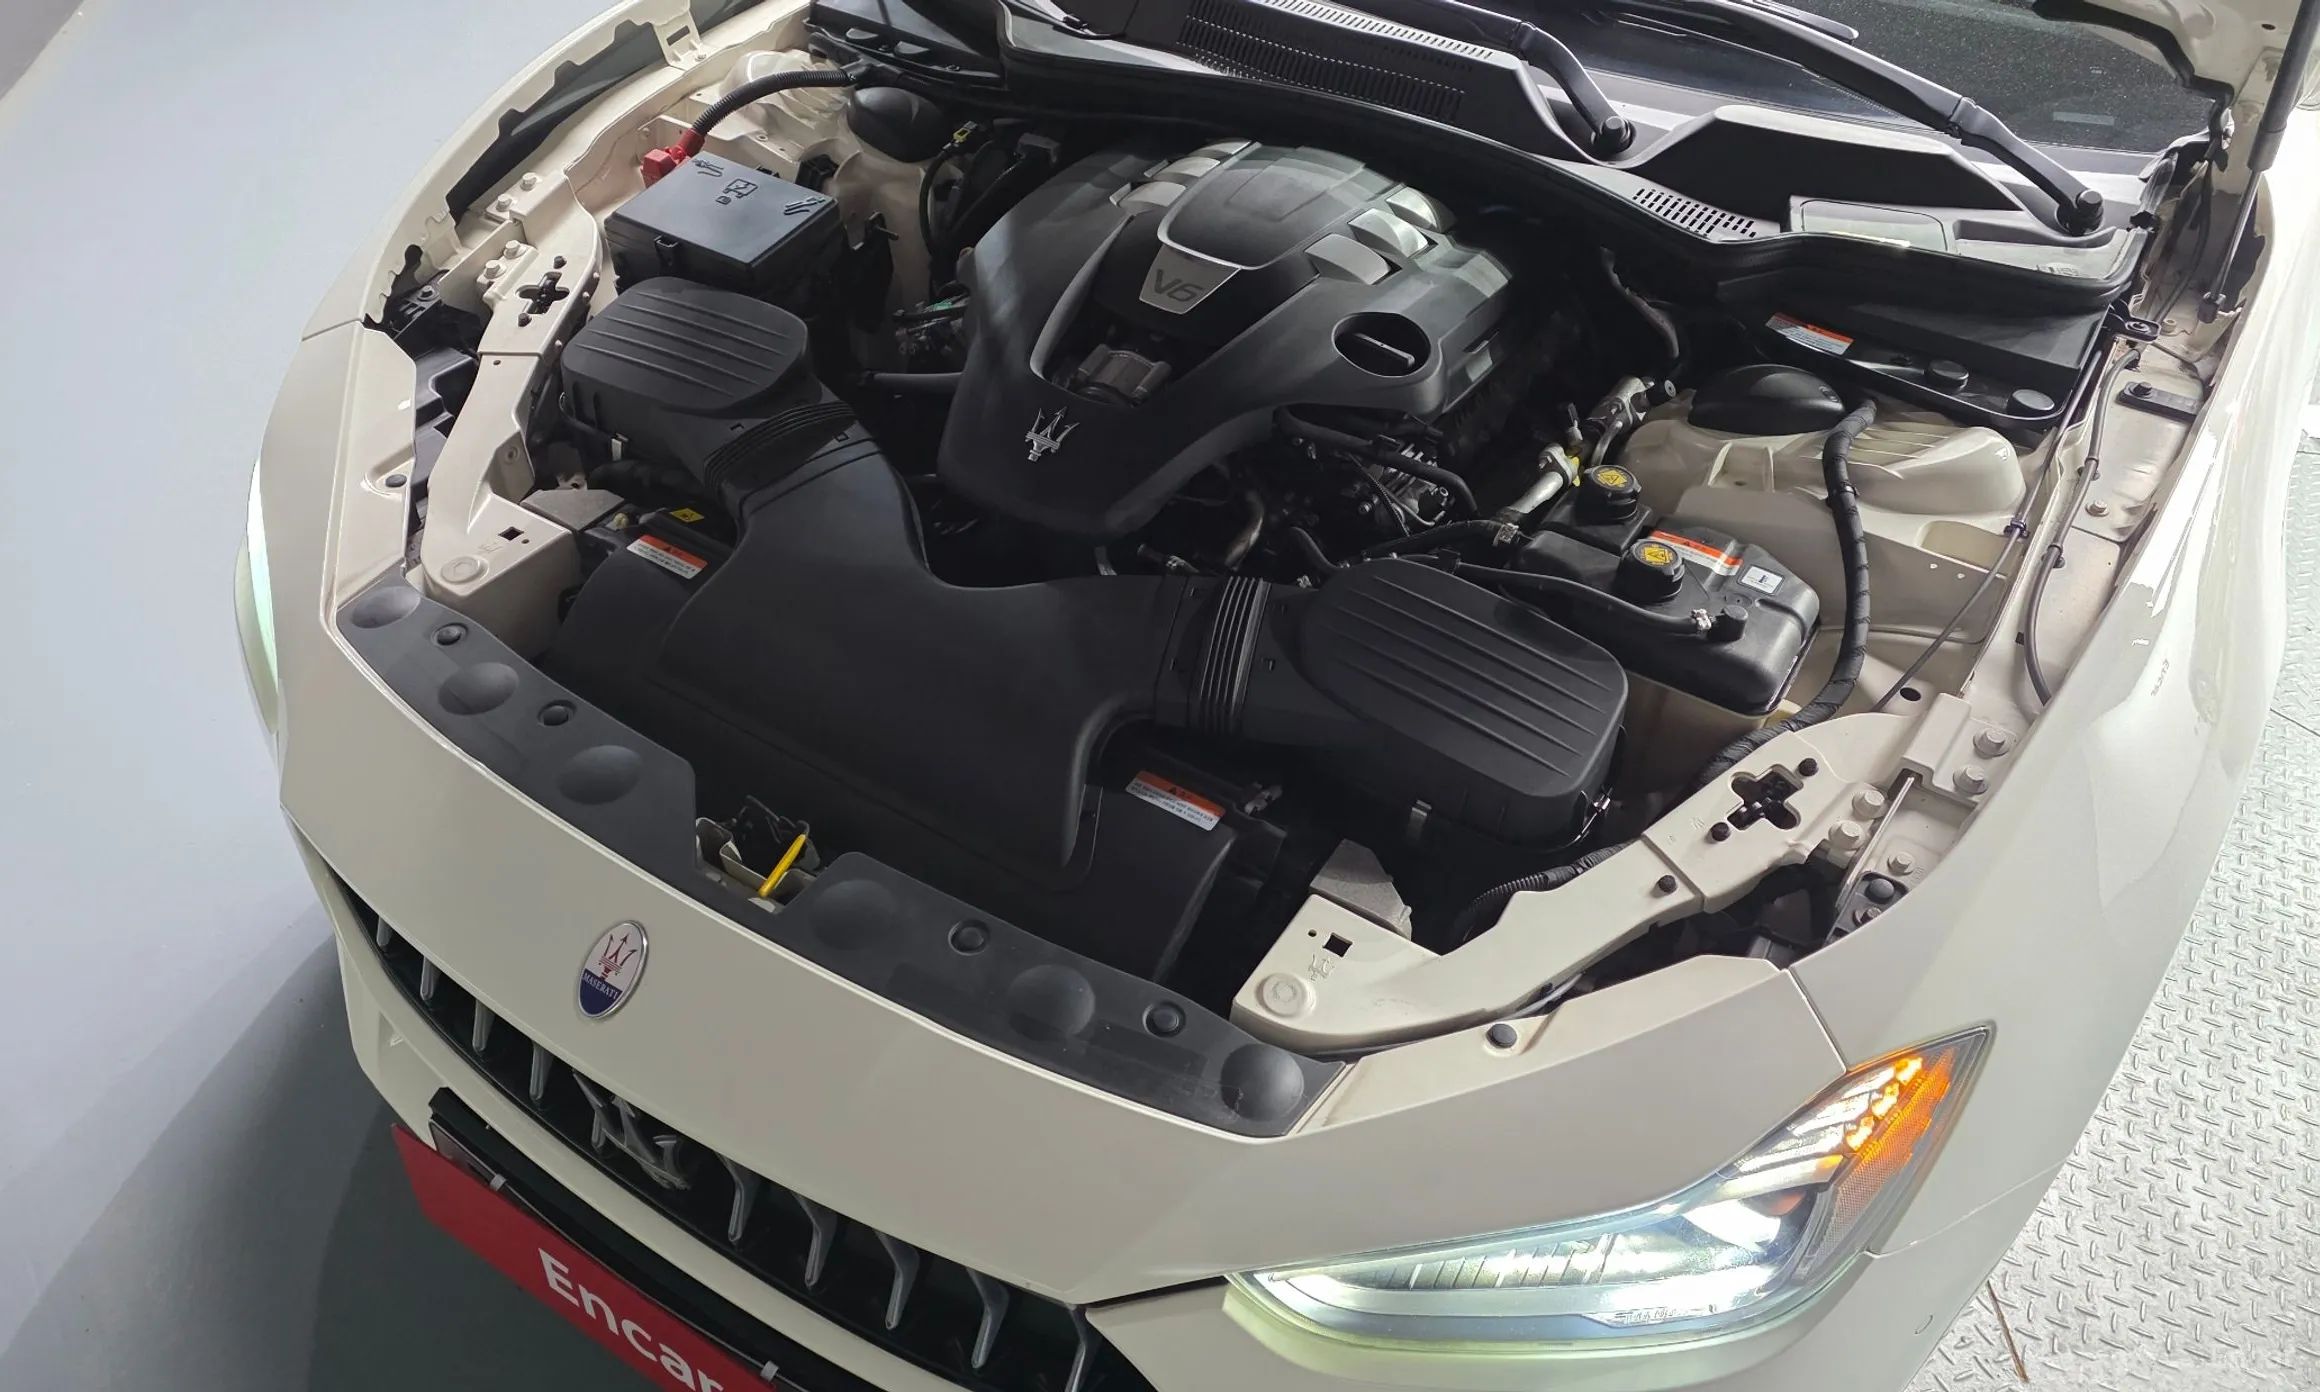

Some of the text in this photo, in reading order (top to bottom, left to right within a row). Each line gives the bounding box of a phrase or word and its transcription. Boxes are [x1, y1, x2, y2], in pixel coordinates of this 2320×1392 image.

[1154, 269, 1204, 302] V6
[582, 973, 618, 999] MASERATI
[537, 1247, 724, 1392] Encar
